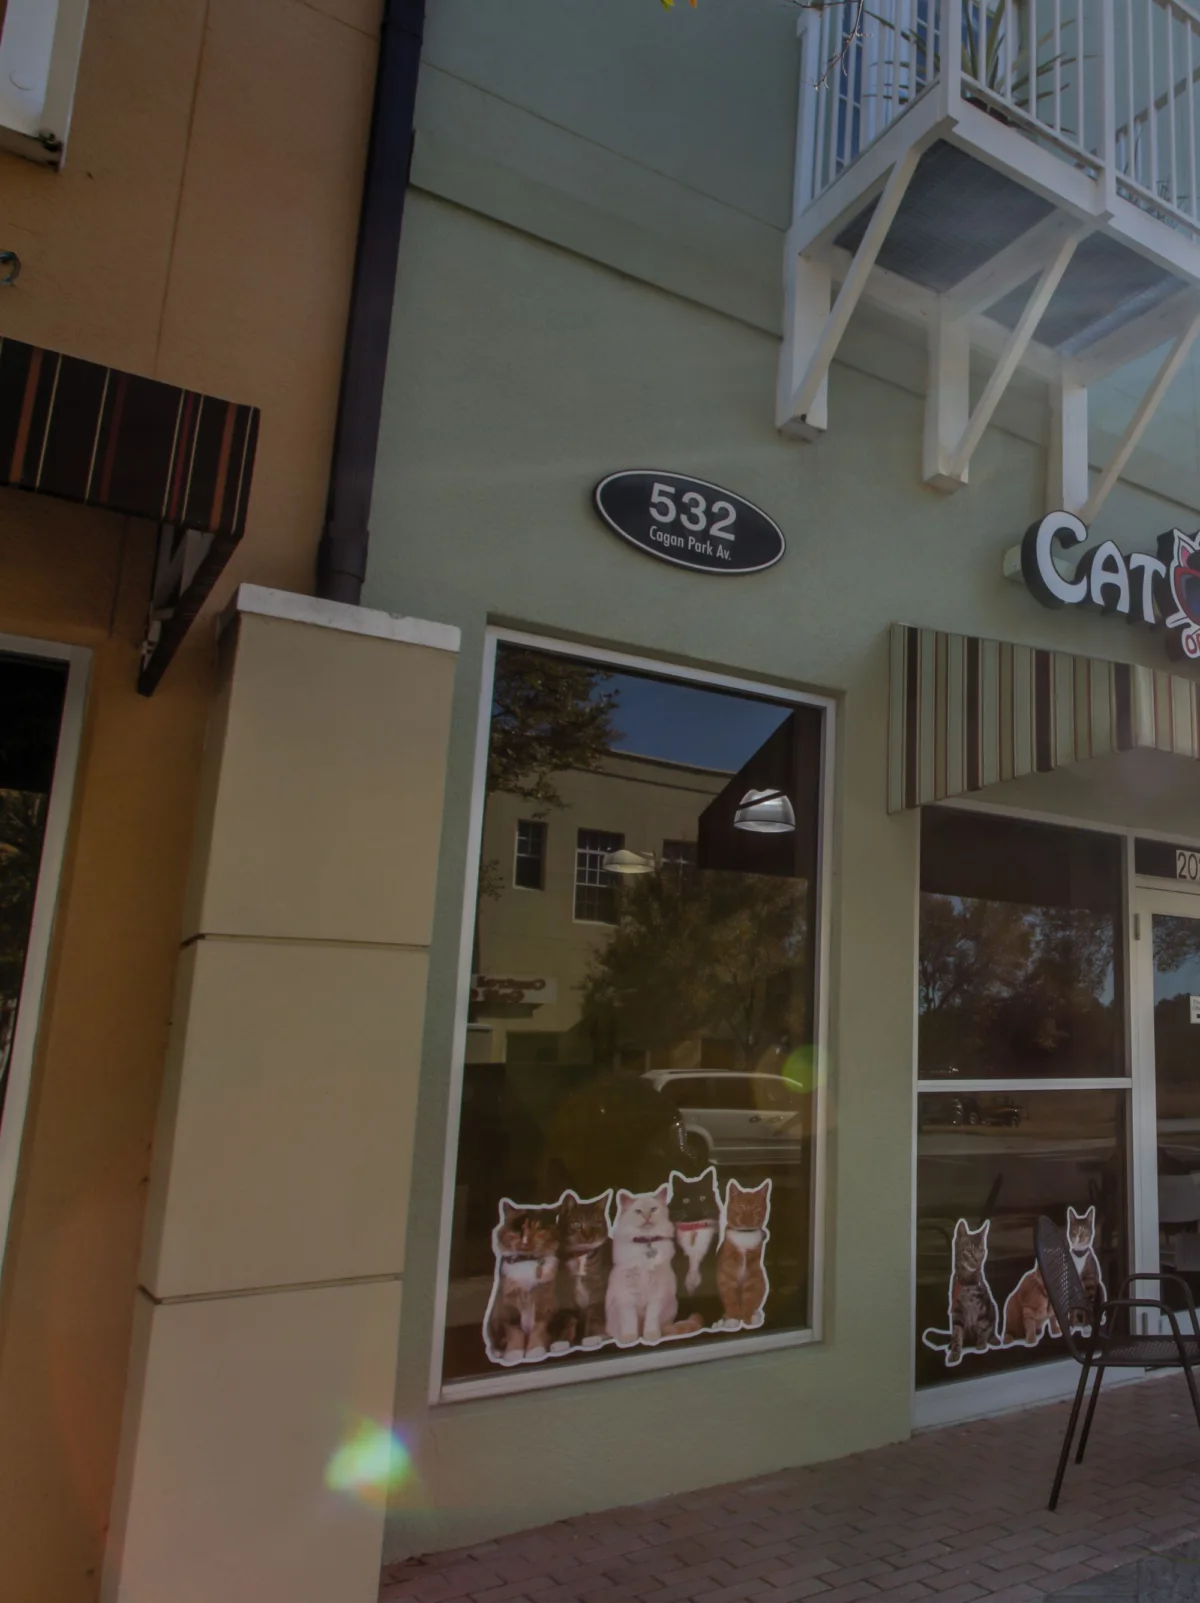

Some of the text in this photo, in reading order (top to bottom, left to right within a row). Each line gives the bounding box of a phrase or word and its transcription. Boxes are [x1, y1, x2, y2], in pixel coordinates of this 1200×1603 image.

[649, 482, 737, 541] 532
[649, 525, 732, 561] Cagan Park Av.
[1034, 510, 1166, 624] CAT
